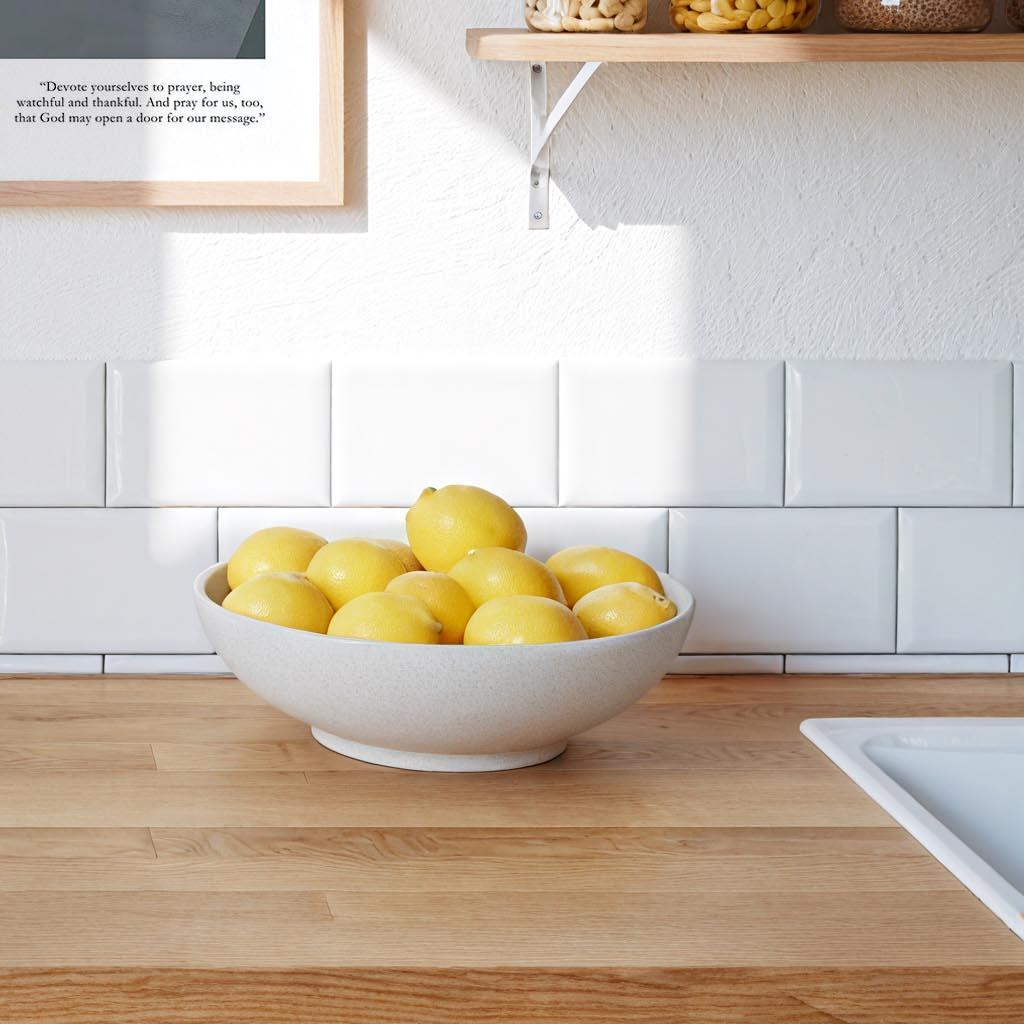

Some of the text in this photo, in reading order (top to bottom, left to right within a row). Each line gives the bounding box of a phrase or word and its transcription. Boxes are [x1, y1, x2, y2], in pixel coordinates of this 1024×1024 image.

[39, 81, 241, 95] “Devote yourselves to prayer, being
[16, 97, 264, 111] watchful and thankful. And pray for us, too,
[14, 112, 266, 126] that God may open a door for our message.”
